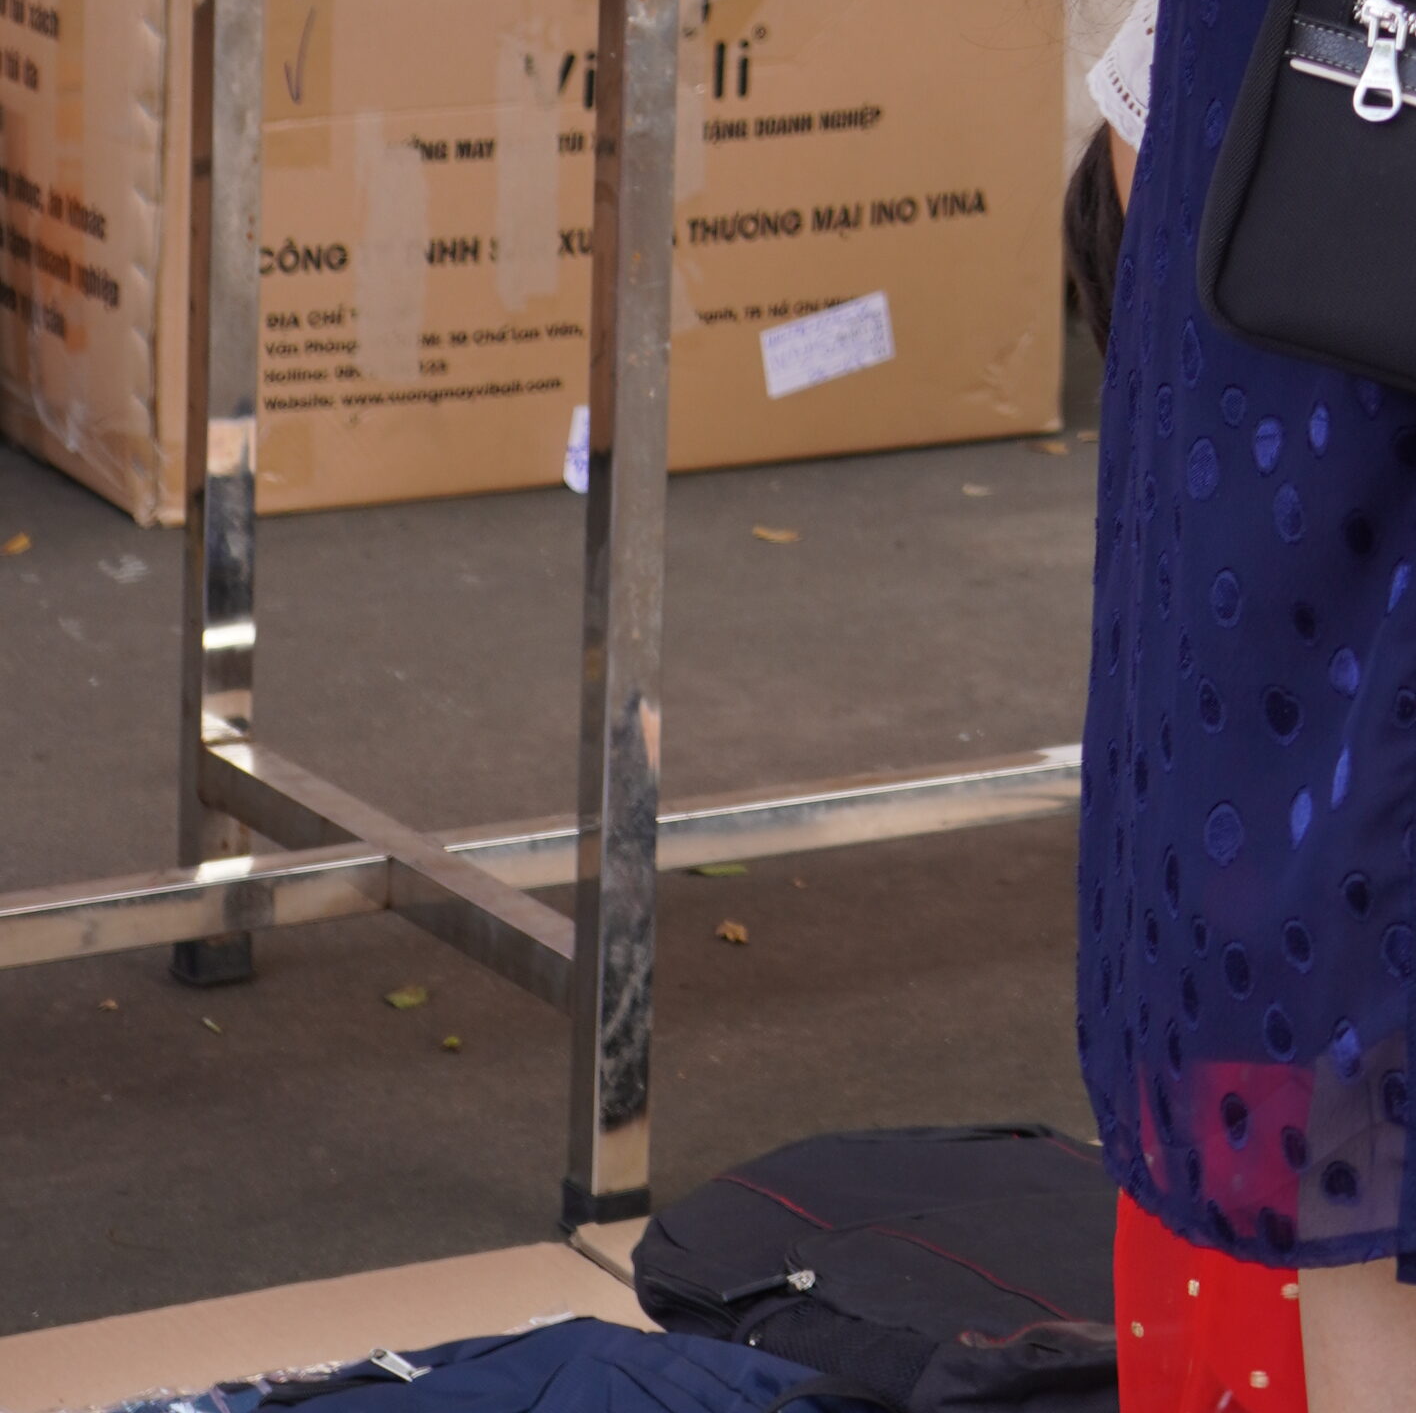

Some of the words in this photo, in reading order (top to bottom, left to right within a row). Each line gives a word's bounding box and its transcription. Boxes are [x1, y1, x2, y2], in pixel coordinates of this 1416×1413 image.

[258, 237, 348, 275] CÔNG
[688, 208, 801, 247] THƯƠNG
[810, 202, 863, 239] MẠI
[870, 197, 918, 224] INO
[924, 188, 986, 220] VINA
